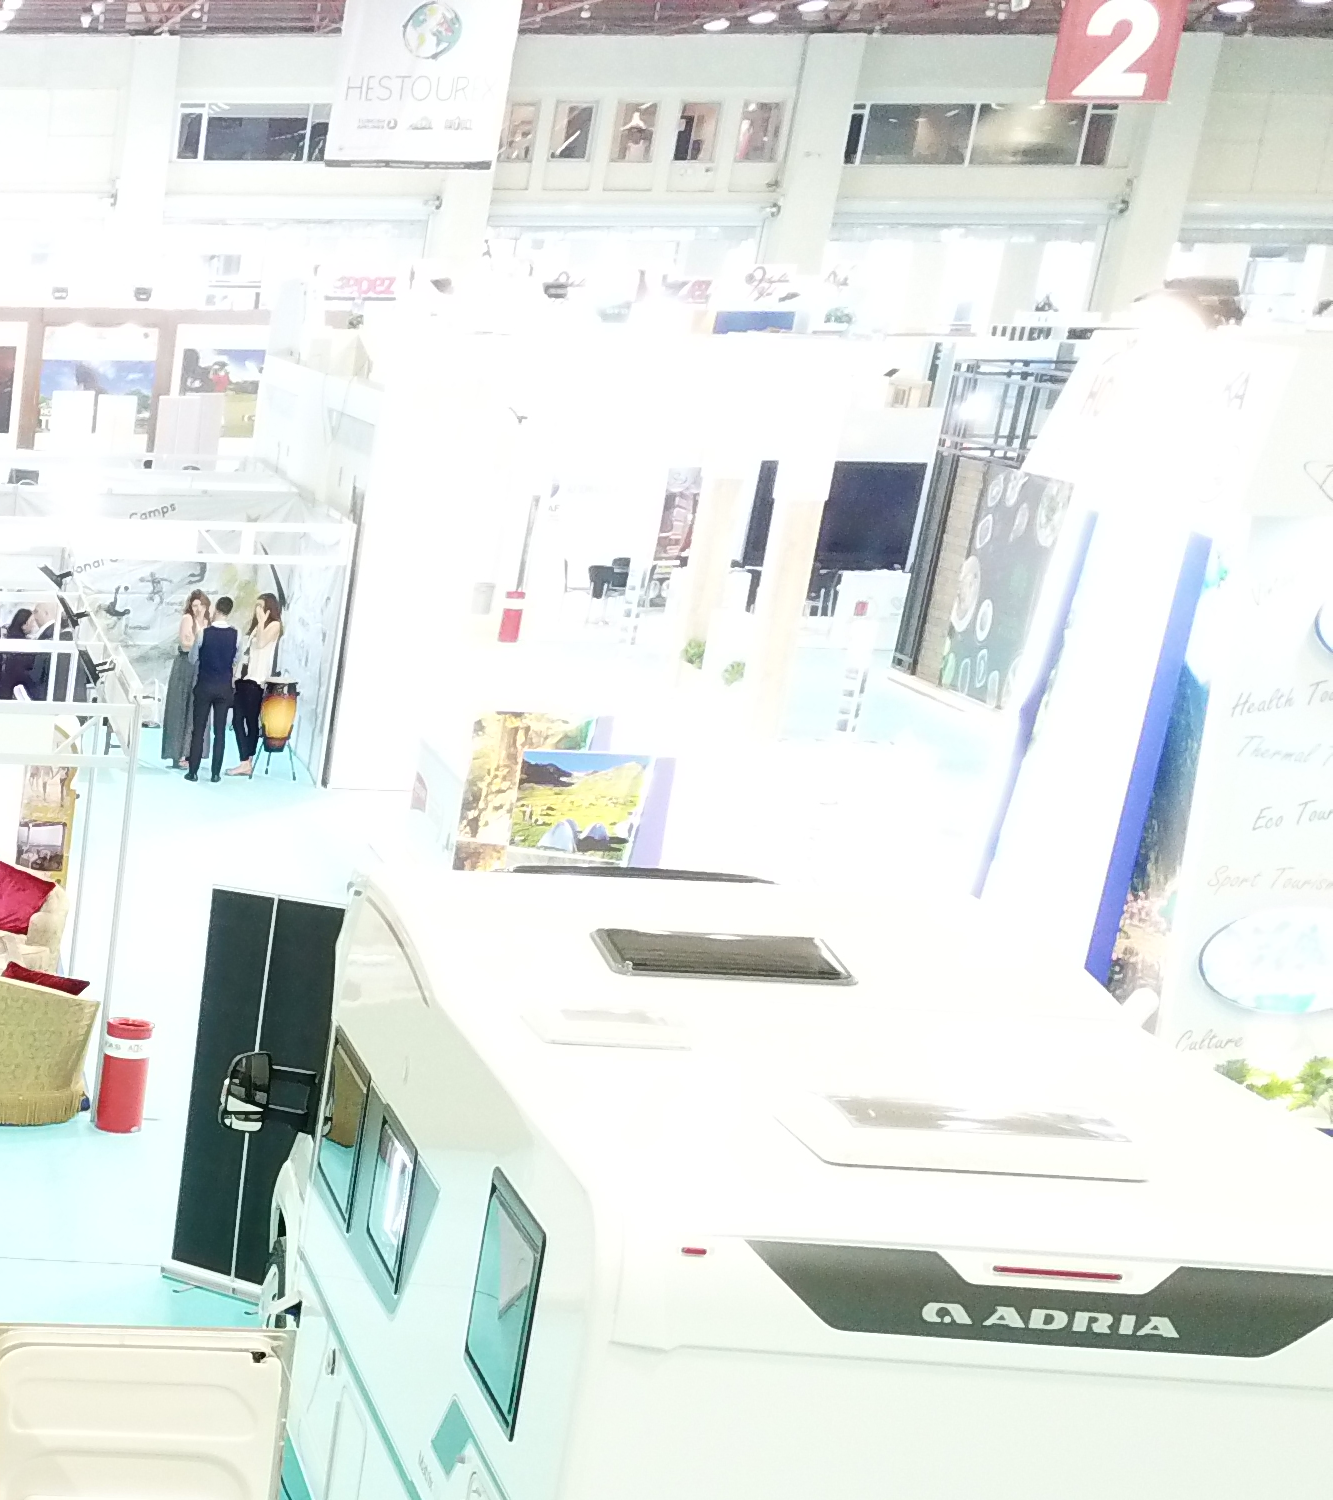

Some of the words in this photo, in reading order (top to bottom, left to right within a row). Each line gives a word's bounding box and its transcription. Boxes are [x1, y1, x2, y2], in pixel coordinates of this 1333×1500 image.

[1072, 0, 1160, 96] 2
[345, 75, 498, 102] HESTOUREX
[1231, 686, 1296, 718] Health
[1236, 735, 1316, 766] Thermal
[1252, 806, 1283, 832] Eco
[1207, 865, 1262, 895] Sport
[981, 1305, 1181, 1340] ADRIA
